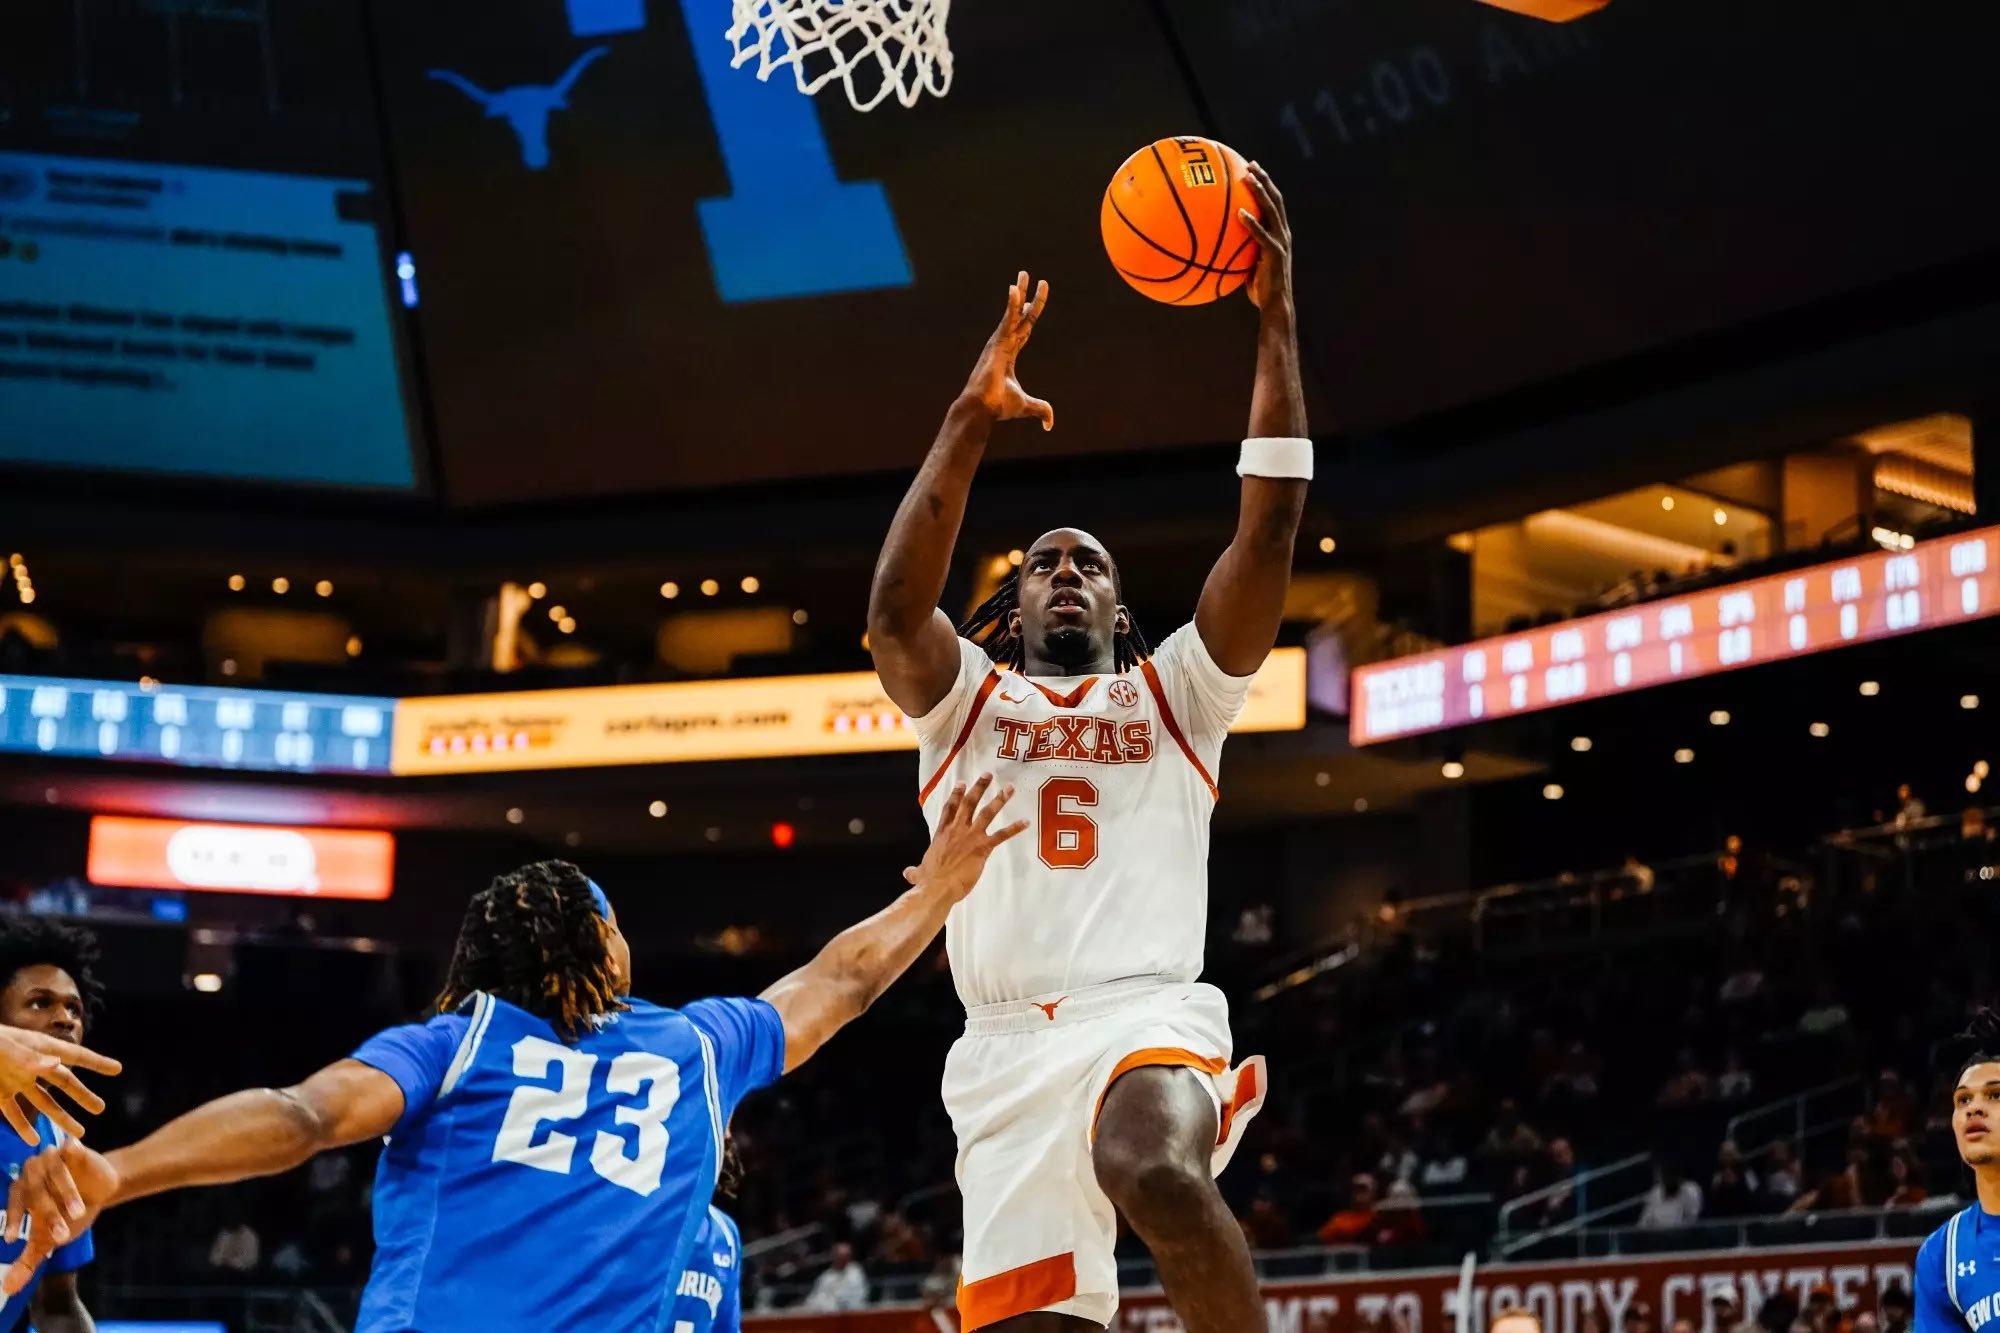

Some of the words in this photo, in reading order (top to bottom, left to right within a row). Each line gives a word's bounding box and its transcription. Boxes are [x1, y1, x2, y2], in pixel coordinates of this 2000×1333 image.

[1280, 43, 1451, 159] 11:00
[1109, 680, 1138, 707] SEC
[994, 715, 1154, 764] TEXAS
[1038, 776, 1099, 869] 6
[492, 1035, 680, 1197] 23
[1965, 1295, 1992, 1333] EW
